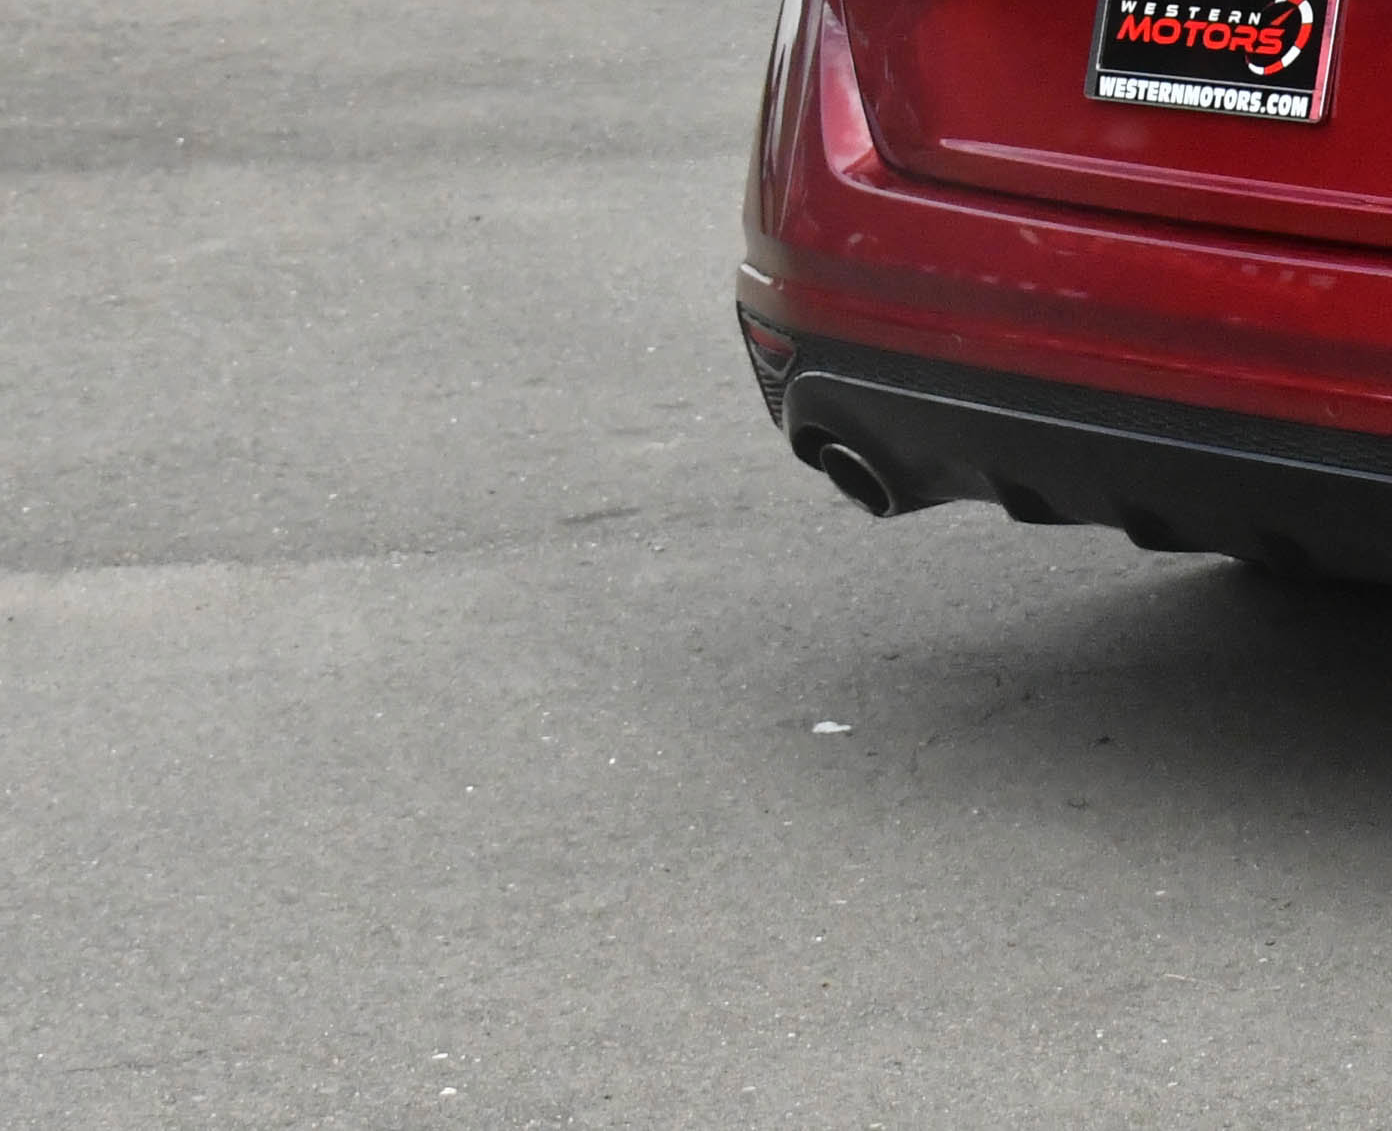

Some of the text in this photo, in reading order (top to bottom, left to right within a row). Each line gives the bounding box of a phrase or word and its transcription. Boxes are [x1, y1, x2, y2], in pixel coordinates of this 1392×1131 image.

[1116, 13, 1286, 55] MOTORS
[1120, 0, 1262, 26] WESTERN
[1099, 75, 1309, 118] WESTERNMOTORS.COM
